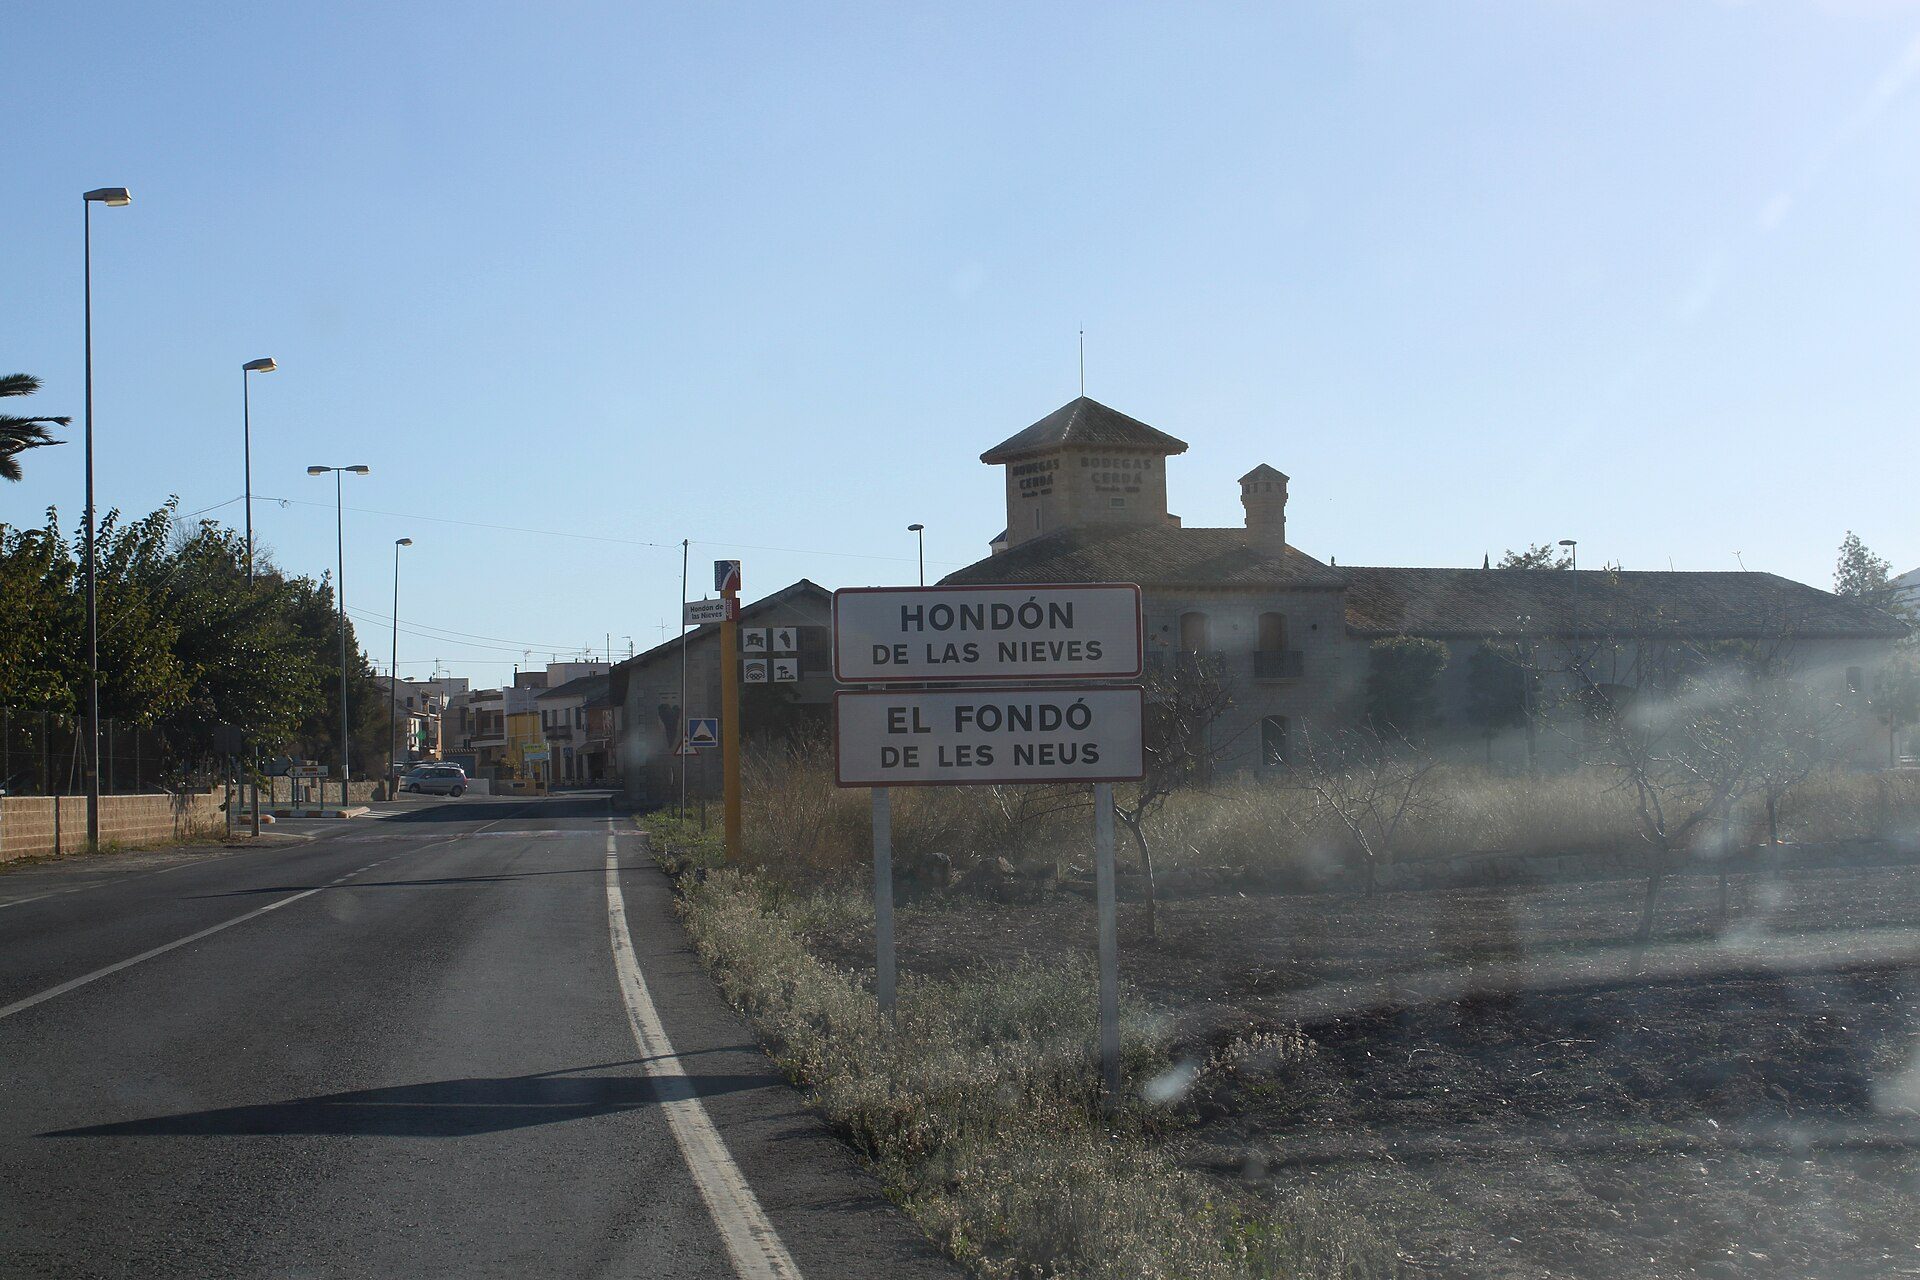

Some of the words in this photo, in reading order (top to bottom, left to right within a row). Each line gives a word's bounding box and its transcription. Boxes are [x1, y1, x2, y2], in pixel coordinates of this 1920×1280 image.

[1081, 457, 1151, 469] BODEGAS
[690, 604, 713, 612] Hondón
[901, 596, 1073, 632] HONDÓN
[873, 644, 909, 665] DE
[927, 642, 980, 664] LAS
[998, 640, 1103, 663] NIEVES
[887, 706, 931, 734] EL
[955, 698, 1092, 733] FONDÓ
[881, 746, 919, 769] DE
[938, 744, 994, 767] LES
[1014, 742, 1099, 766] NEUS
